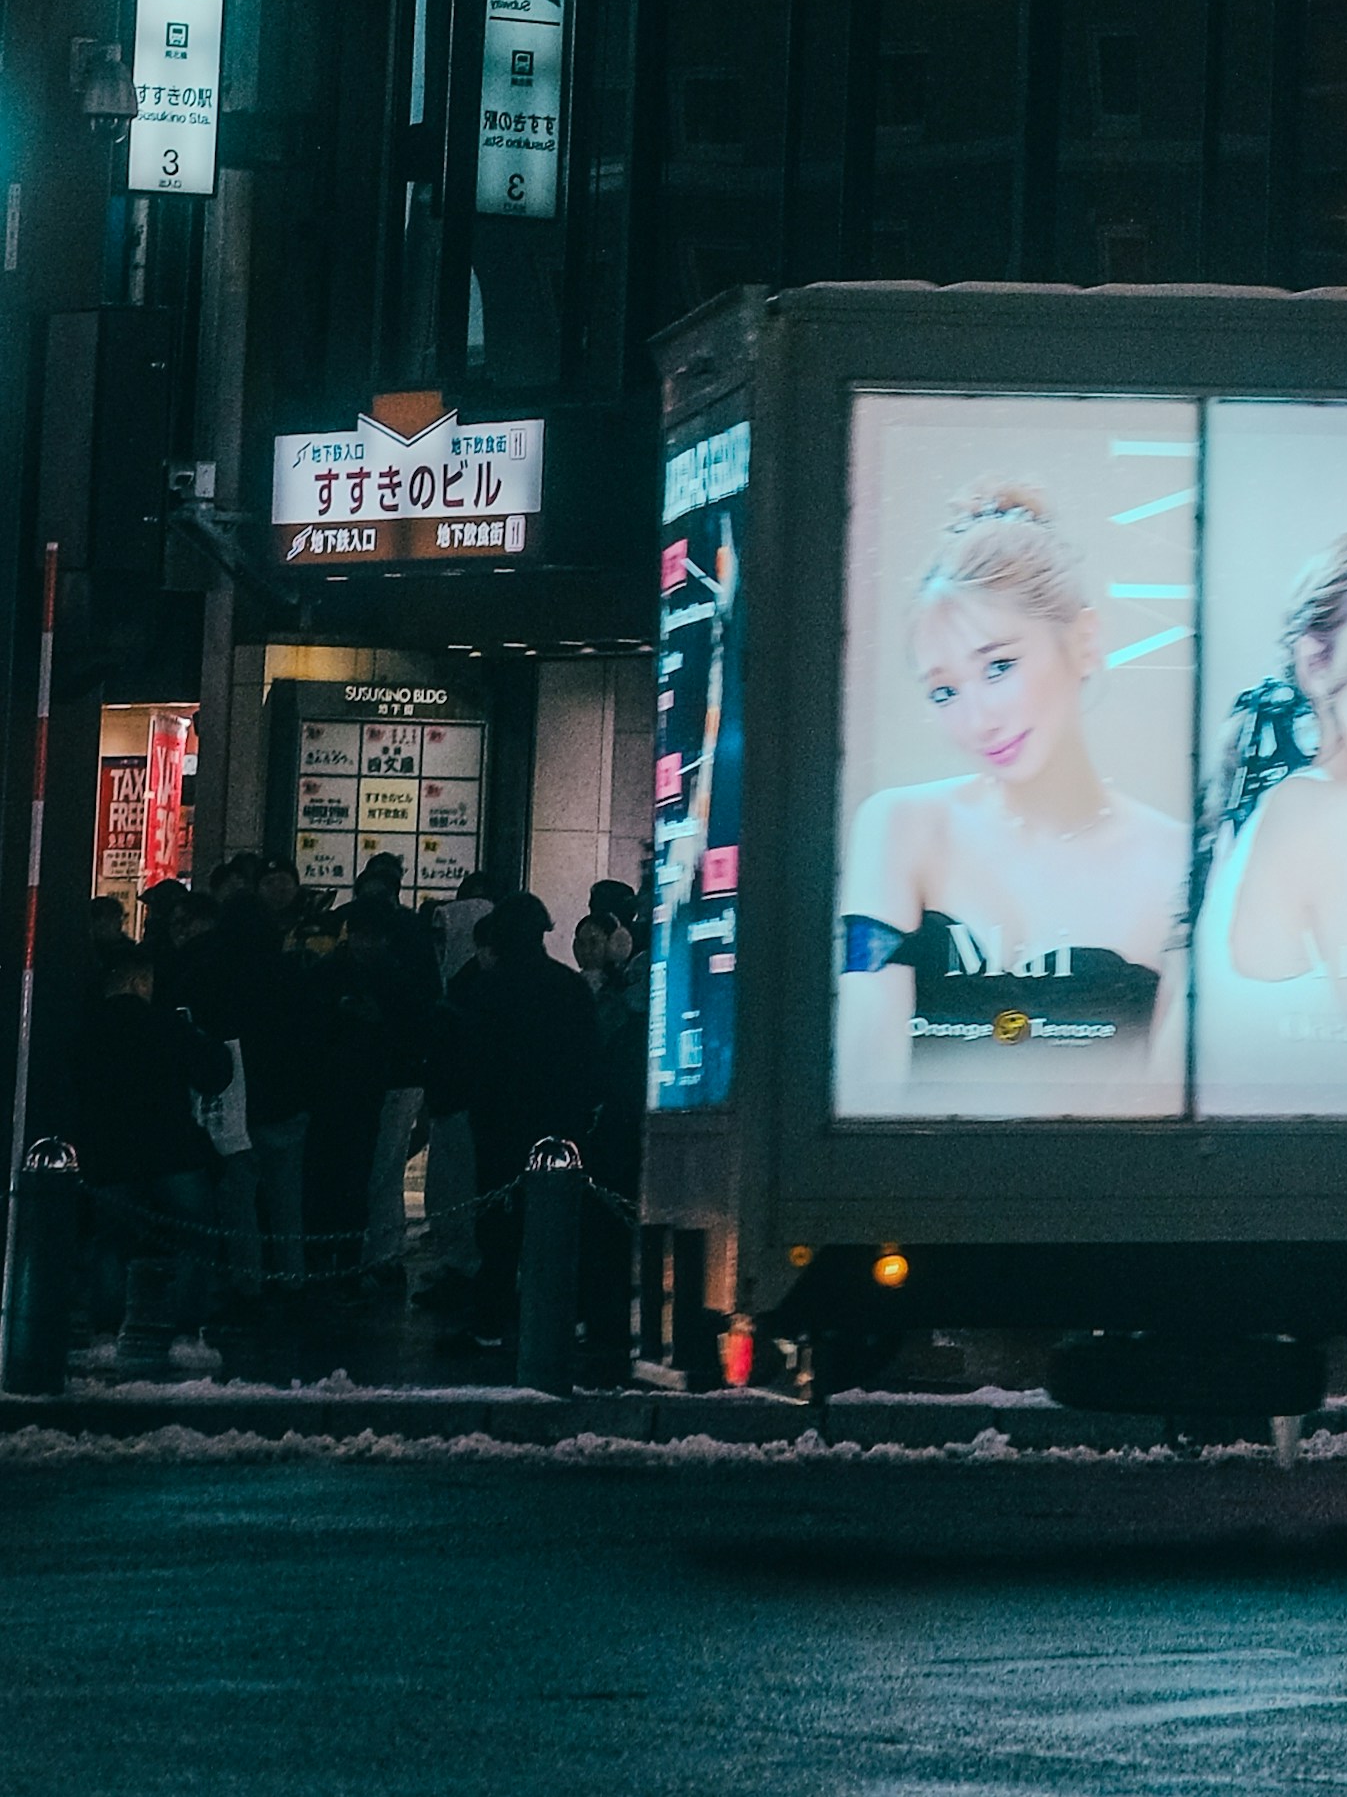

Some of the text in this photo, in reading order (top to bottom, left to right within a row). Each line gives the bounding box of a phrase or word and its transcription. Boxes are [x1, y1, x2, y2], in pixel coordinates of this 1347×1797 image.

[137, 84, 212, 108] すすきの駅
[162, 148, 180, 177] 3
[311, 442, 365, 464] 地下鉄入口
[450, 433, 507, 457] 地下飲食街
[314, 459, 502, 517] すすきのビル
[310, 527, 377, 555] 地下鉄入口
[435, 521, 505, 548] 地下飲食街
[344, 685, 449, 705] SUSUKINO BLDG
[110, 767, 146, 802] TAX
[108, 801, 146, 833] FREE
[944, 924, 1073, 978] Mai
